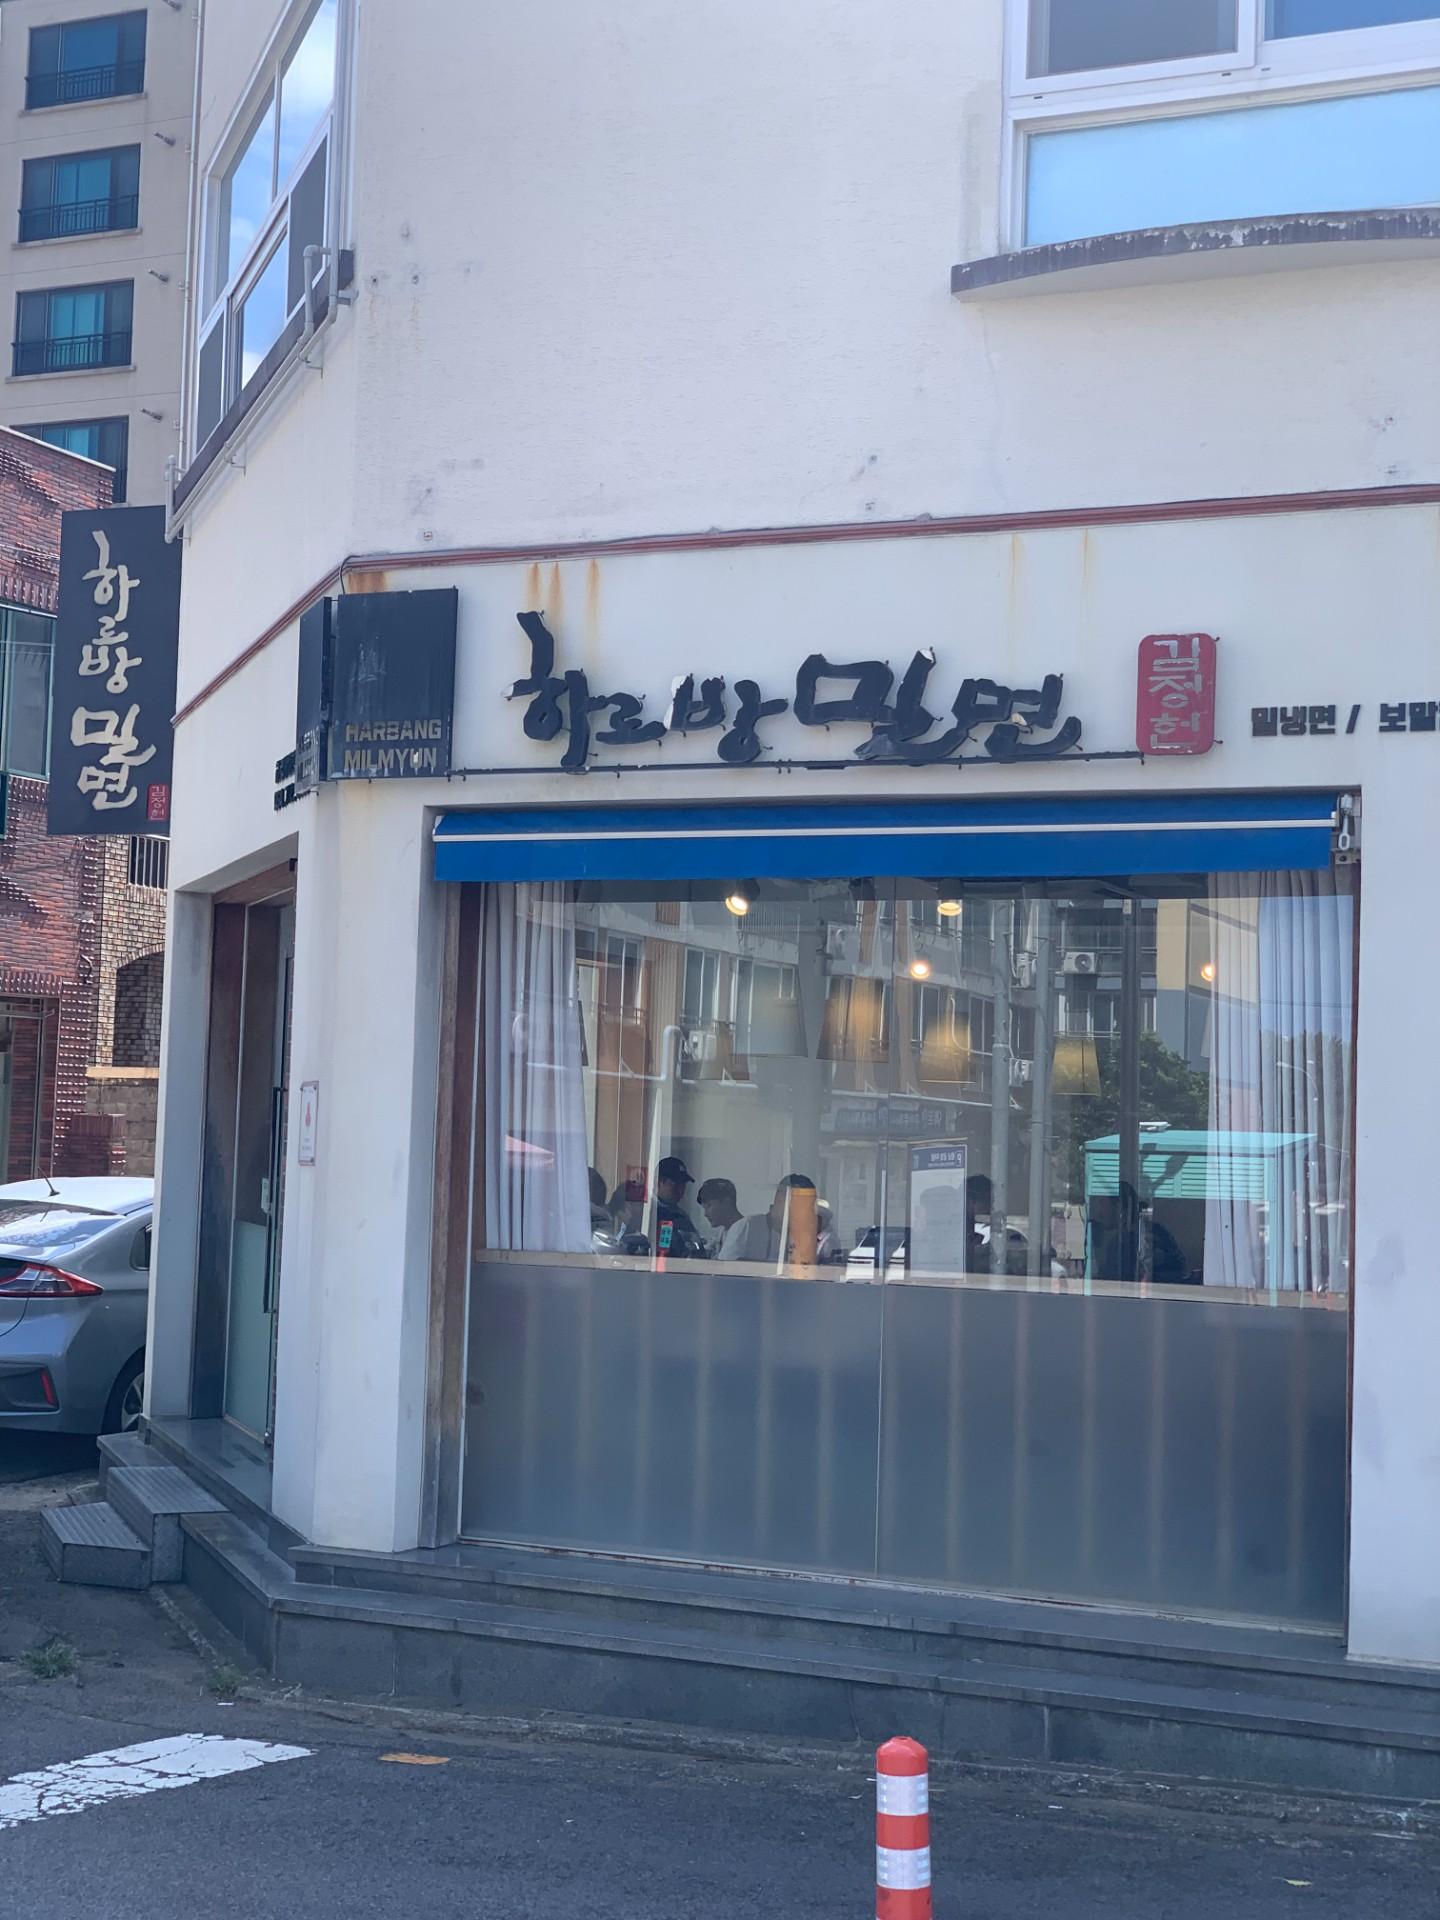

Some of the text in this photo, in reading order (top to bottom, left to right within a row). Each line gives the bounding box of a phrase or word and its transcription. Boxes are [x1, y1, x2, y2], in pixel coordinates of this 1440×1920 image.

[346, 719, 442, 742] HARBANG
[1251, 704, 1336, 736] 밀냉면
[1379, 701, 1440, 732] 보말
[344, 747, 437, 771] MILMYUN
